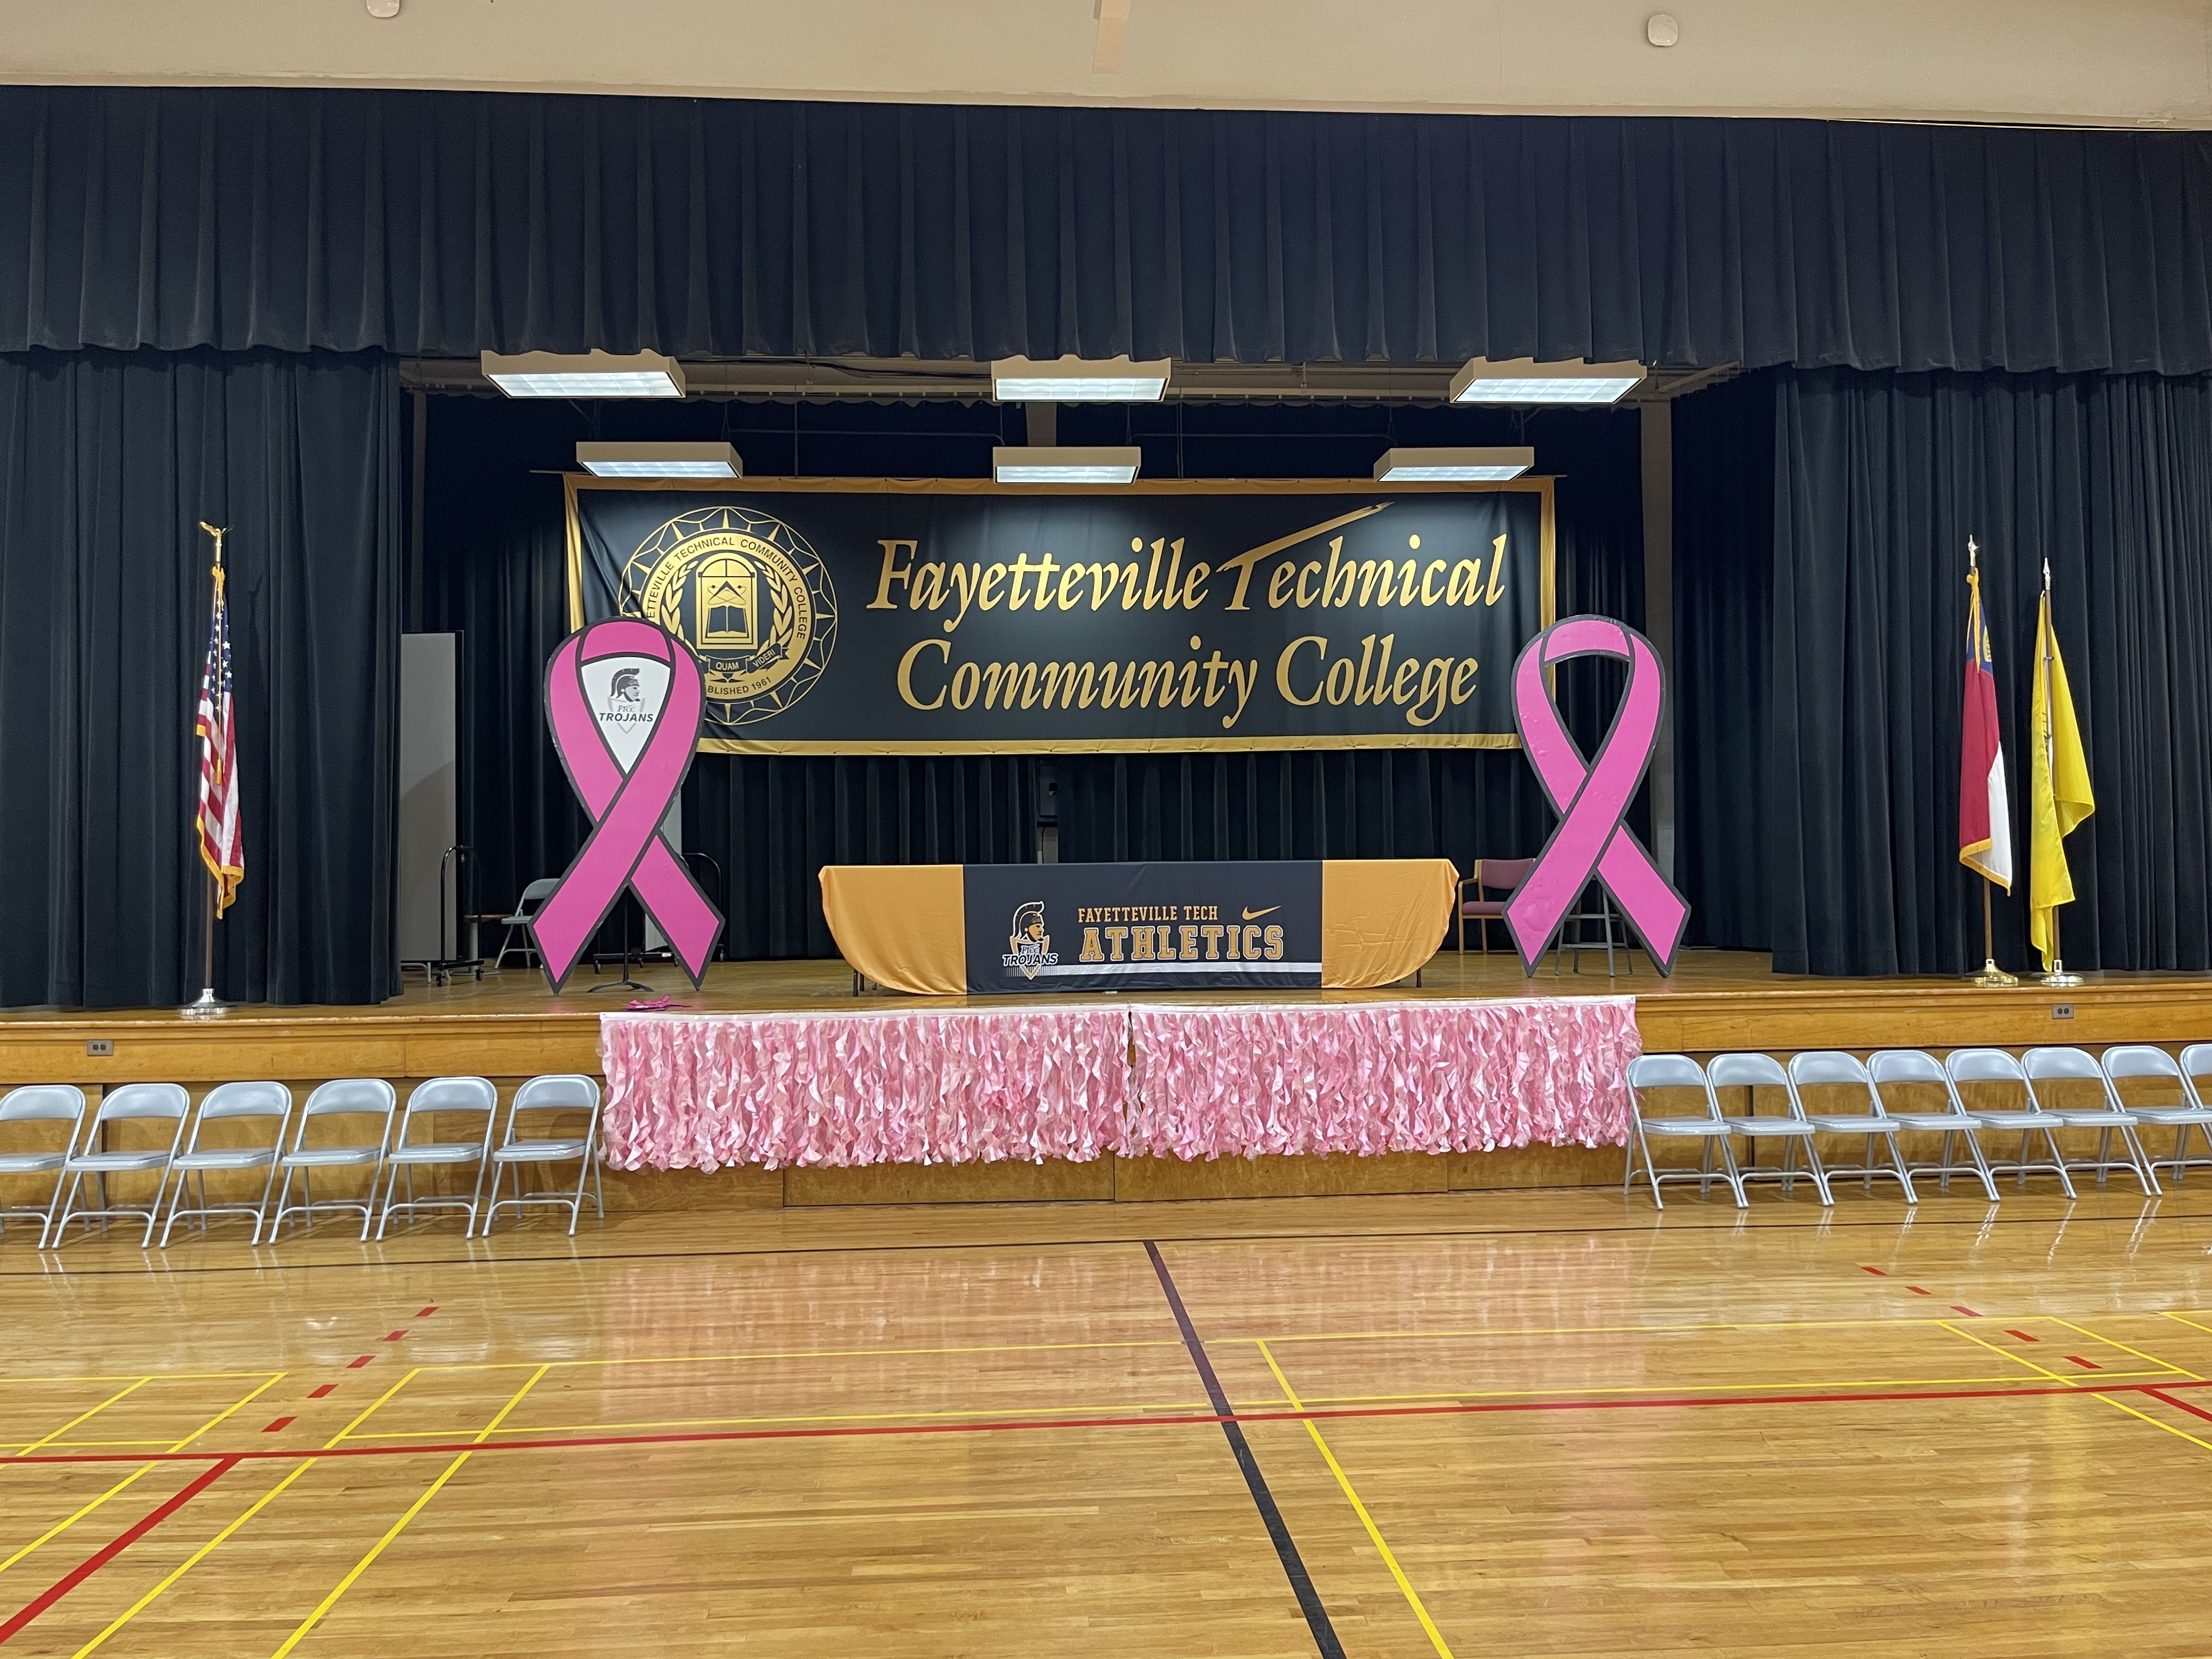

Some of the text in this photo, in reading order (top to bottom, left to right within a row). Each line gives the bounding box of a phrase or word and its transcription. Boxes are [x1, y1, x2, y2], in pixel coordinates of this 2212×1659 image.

[866, 501, 1507, 633] Fayetteville Technical
[646, 537, 808, 640] ETTEVILLE TECHNICAL COMMUNITY COLLEGE
[715, 649, 776, 670] QUAM VIDERI
[707, 676, 772, 695] BLISHED 1961
[897, 633, 1479, 729] Community College
[599, 713, 654, 722] TROJANS
[618, 704, 636, 713] FTCC
[1078, 905, 1218, 923] FAYETTEVILLE TECH
[1021, 944, 1040, 955] FTCC
[1079, 925, 1284, 962] ATHLETICS
[1002, 953, 1059, 966] TROJANS
